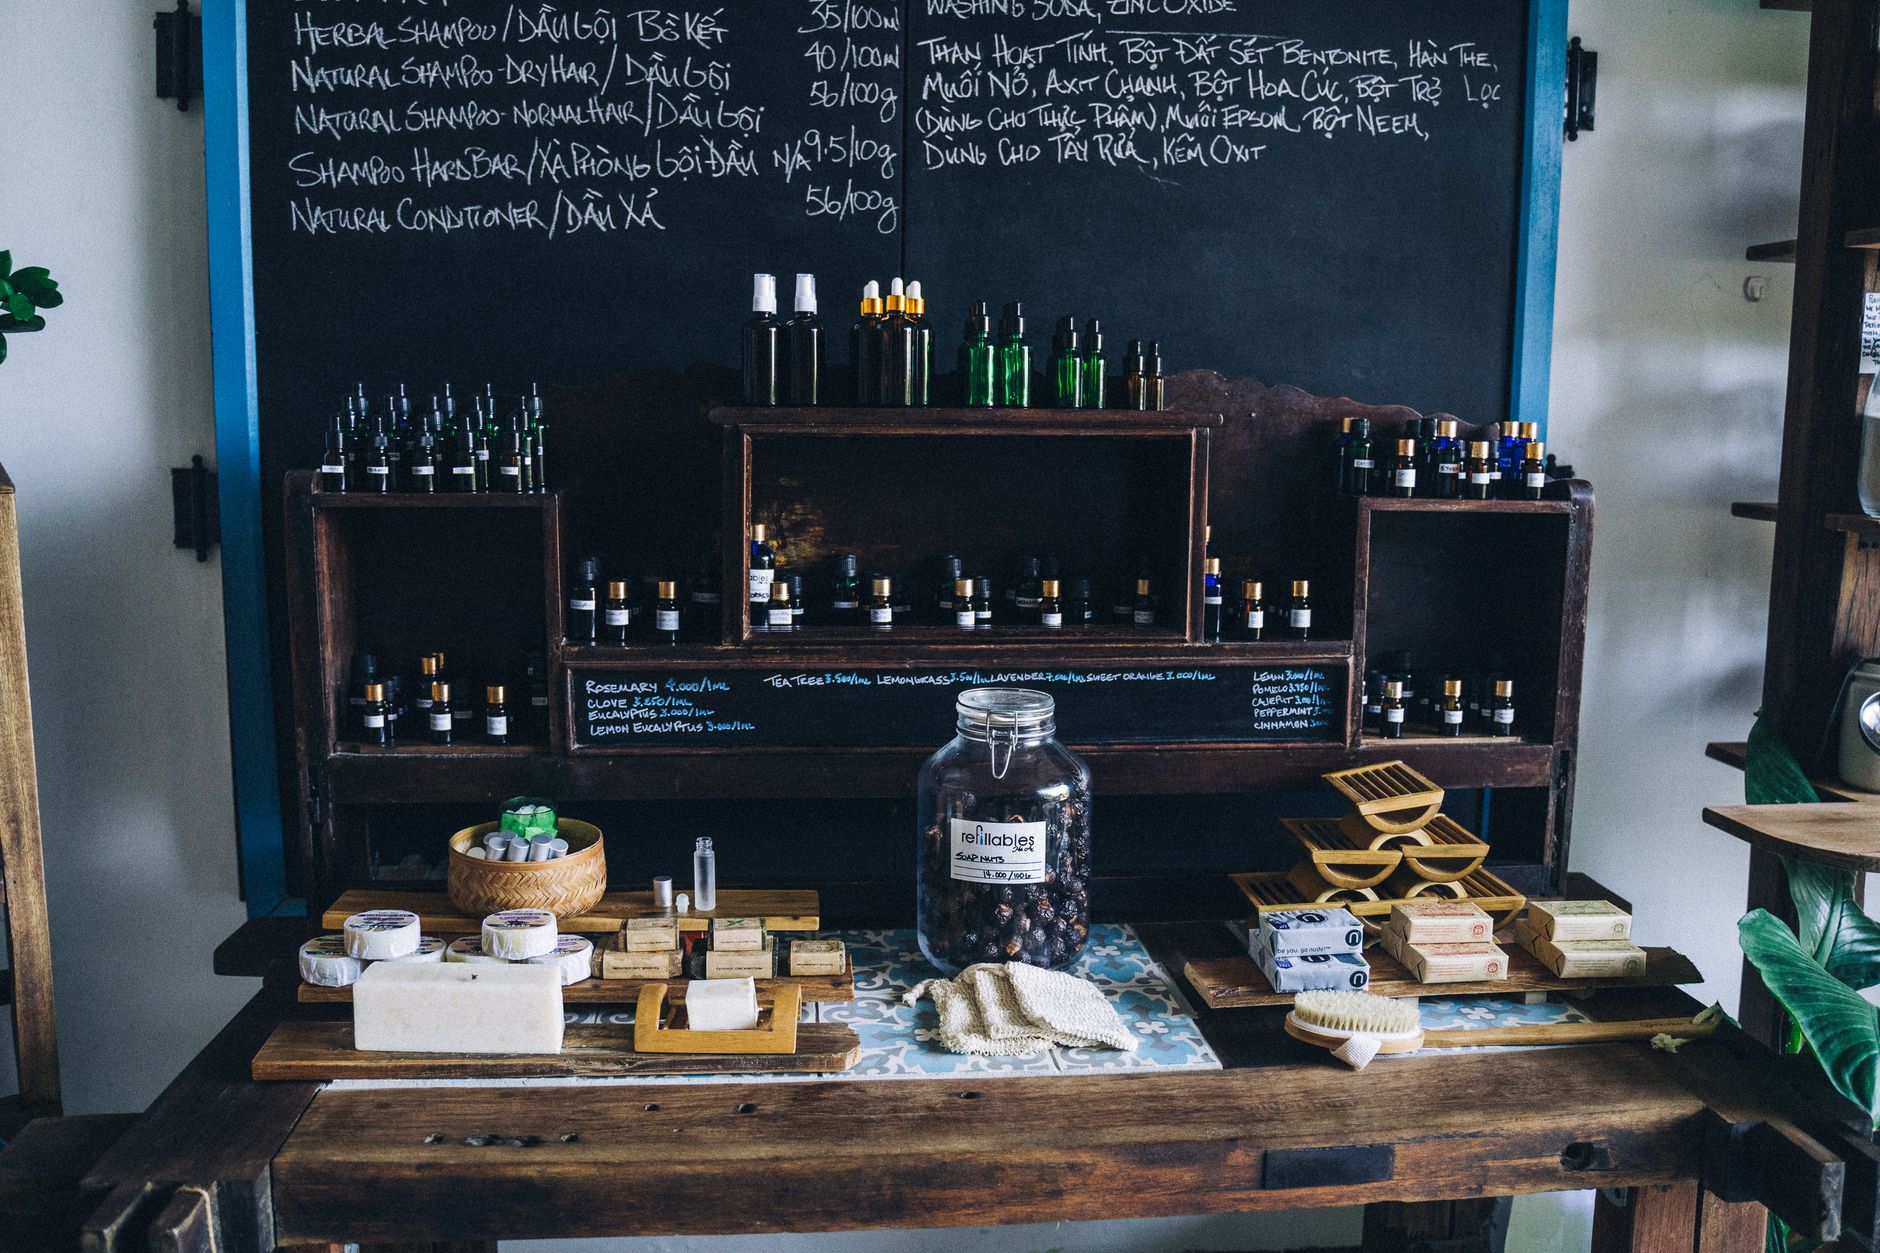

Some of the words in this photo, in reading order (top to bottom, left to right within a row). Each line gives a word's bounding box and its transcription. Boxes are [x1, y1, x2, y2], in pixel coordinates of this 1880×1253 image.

[294, 11, 397, 55] HERBAL
[917, 35, 982, 66] THAN
[1119, 38, 1172, 70] BỘT
[1173, 35, 1222, 66] ĐẤT
[1229, 36, 1273, 65] SÉT
[1408, 39, 1449, 68] HÀN
[291, 56, 401, 93] NATURAL
[1046, 68, 1101, 97] AXIT
[1188, 69, 1243, 101] BỘT
[1248, 69, 1300, 99] HOA
[1349, 74, 1400, 103] BỘT
[1463, 74, 1501, 109] LỌC
[294, 103, 401, 141] NATURAL
[988, 107, 1026, 131] CHO
[1303, 105, 1353, 139] BỘT
[923, 134, 988, 171] DÙNG
[998, 138, 1042, 167] CHO
[1210, 135, 1267, 164] OXIT
[288, 152, 405, 189] SHAMPOO
[290, 197, 392, 235] NATURAL
[763, 673, 792, 688] TEA
[789, 673, 825, 686] TREE
[876, 673, 951, 686] LEMONGRASS
[990, 671, 1047, 683] LAVENDER
[1086, 672, 1122, 682] SWEET
[1122, 671, 1165, 681] ORANGE
[1252, 671, 1285, 682] LEMON
[584, 679, 659, 695] ROSEMARY
[1251, 683, 1289, 695] POMELO
[587, 698, 628, 709] CLOVE
[1251, 694, 1295, 707] CAJEPUT
[587, 707, 658, 722] EUCALYPTUS
[1253, 706, 1314, 718] PEPPERMINT
[589, 723, 630, 737] LEMON
[632, 720, 704, 734] EUCALYPTUS
[1253, 719, 1309, 731] CINNAMON
[961, 825, 1035, 846] refillables
[954, 851, 979, 861] SOAP
[979, 855, 1005, 864] NUTS
